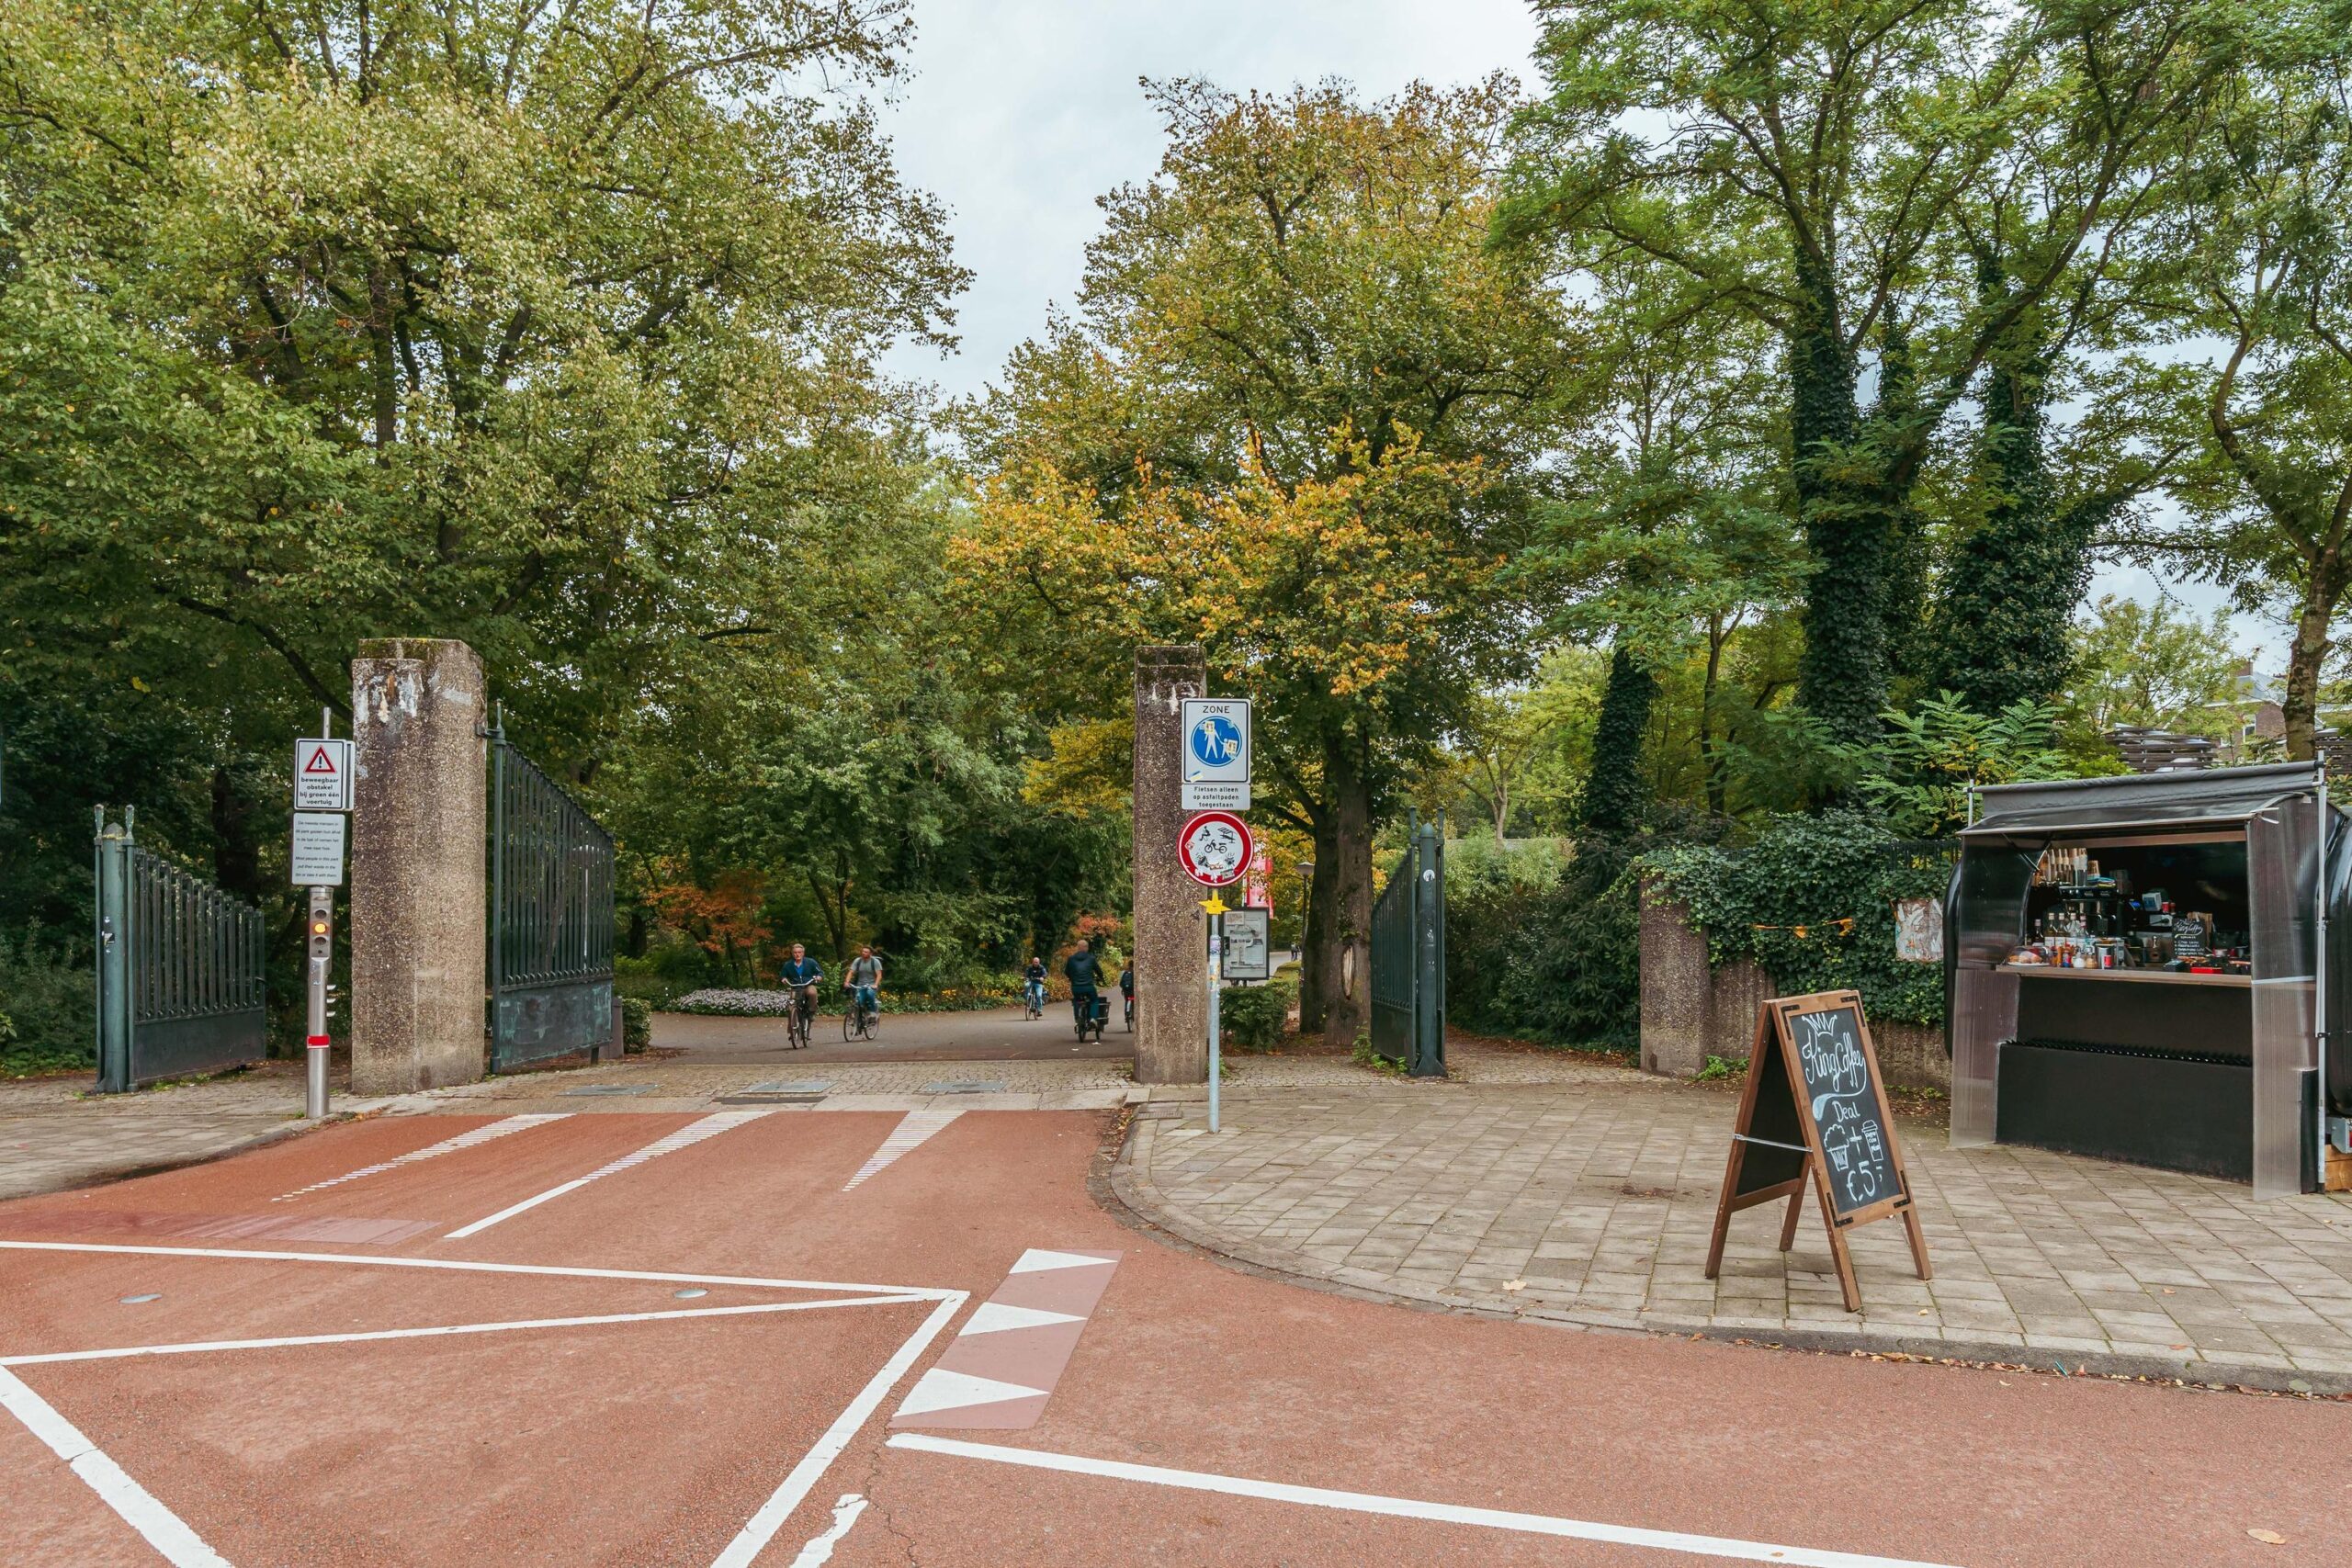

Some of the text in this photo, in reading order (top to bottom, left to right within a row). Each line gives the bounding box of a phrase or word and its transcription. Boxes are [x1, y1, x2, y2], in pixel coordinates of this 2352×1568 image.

[1203, 705, 1230, 714] ZONE
[1802, 1029, 1866, 1093] King Coffee
[1832, 1100, 1860, 1122] Deal
